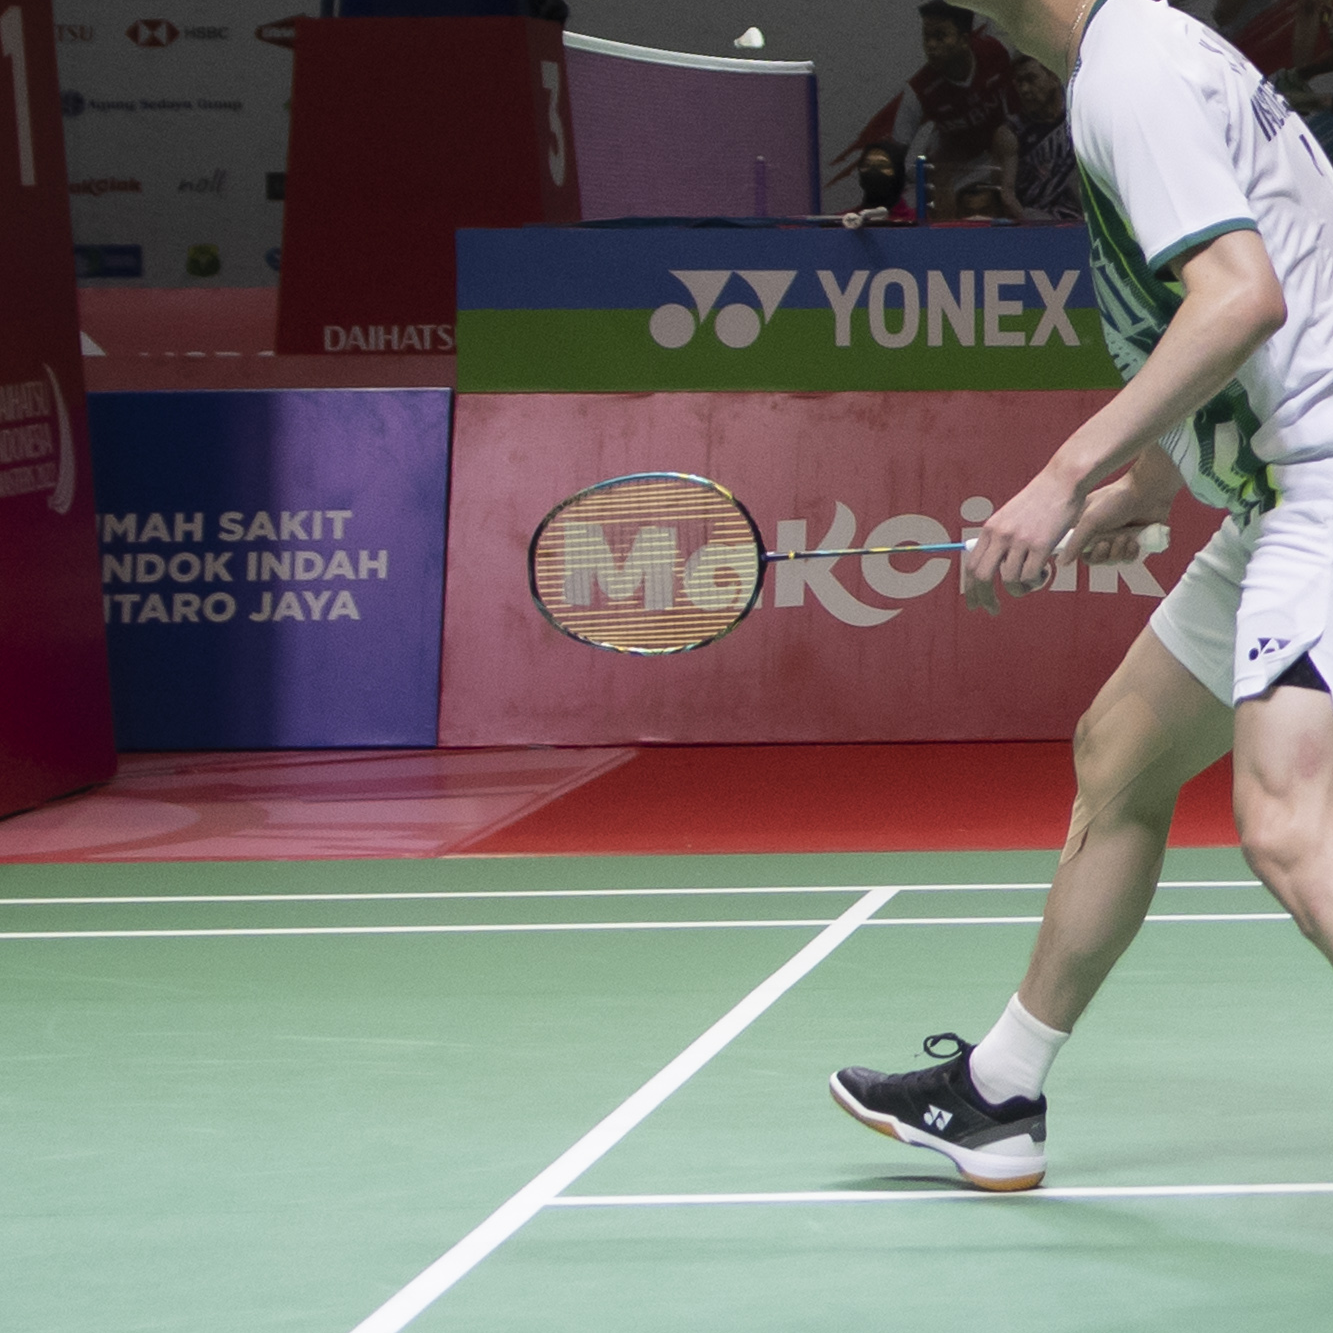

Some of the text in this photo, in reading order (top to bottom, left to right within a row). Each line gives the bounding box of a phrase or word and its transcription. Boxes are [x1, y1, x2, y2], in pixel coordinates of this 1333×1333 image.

[184, 25, 229, 40] HSBC
[540, 60, 567, 187] 3
[815, 269, 1081, 348] YONEX
[96, 509, 353, 543] MAH SAKIT
[246, 549, 389, 581] INDAH
[248, 590, 361, 623] JAYA
